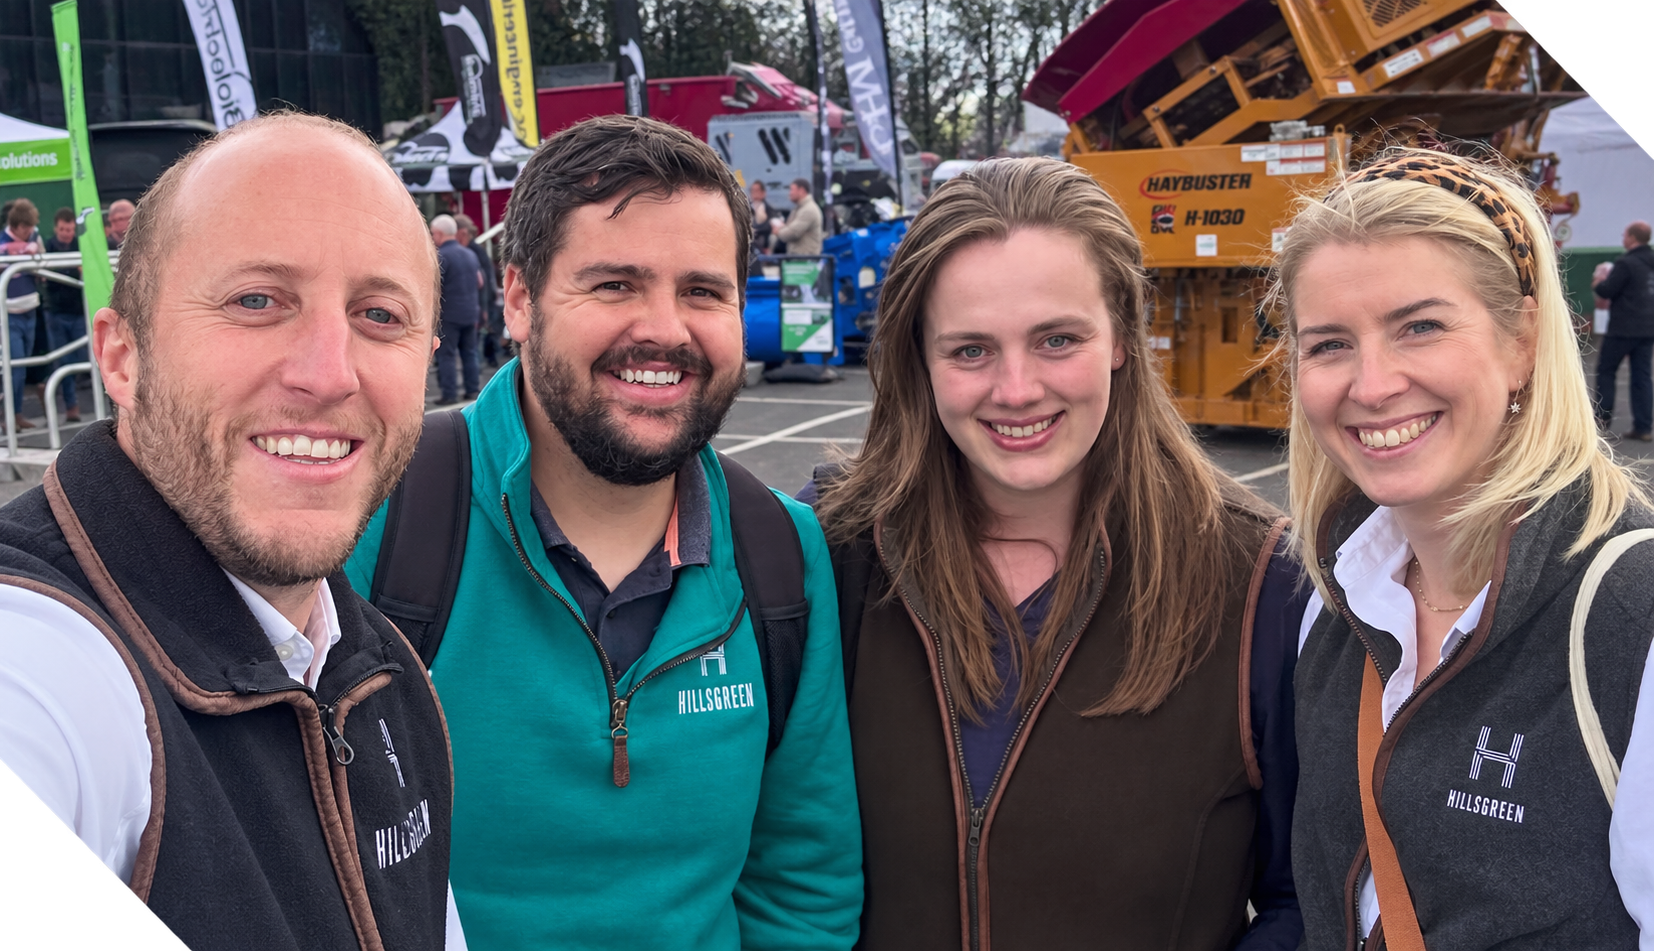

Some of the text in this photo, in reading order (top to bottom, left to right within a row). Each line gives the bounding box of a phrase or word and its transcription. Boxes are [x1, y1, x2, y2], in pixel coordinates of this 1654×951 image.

[0, 151, 58, 170] olutions
[1146, 173, 1252, 192] HAYBUSTER
[1184, 208, 1245, 226] H-1030
[679, 683, 754, 714] HILLSGREEN
[1447, 789, 1524, 823] HILLSGREEN
